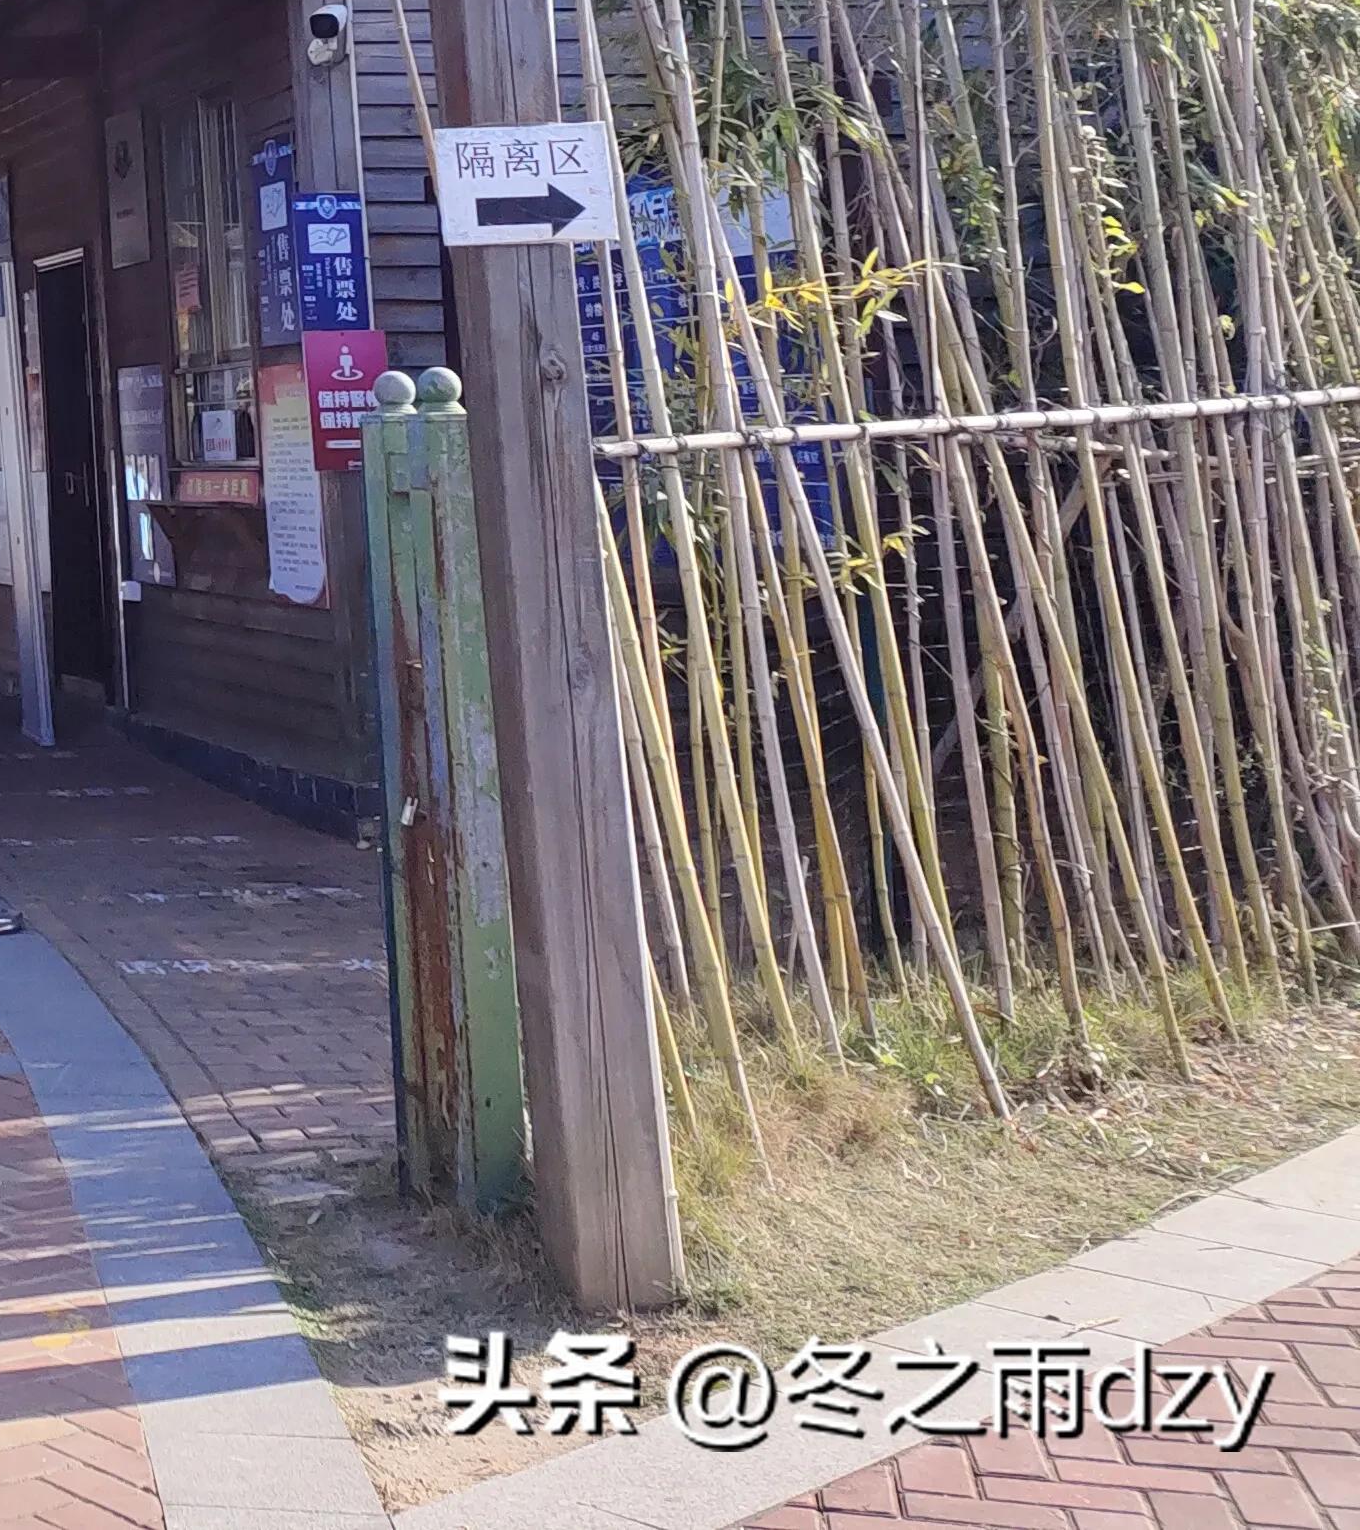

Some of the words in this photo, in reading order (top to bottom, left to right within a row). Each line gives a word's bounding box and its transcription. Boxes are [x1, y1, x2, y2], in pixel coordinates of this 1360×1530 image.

[455, 138, 588, 178] 隔离区
[333, 256, 358, 321] 售票处
